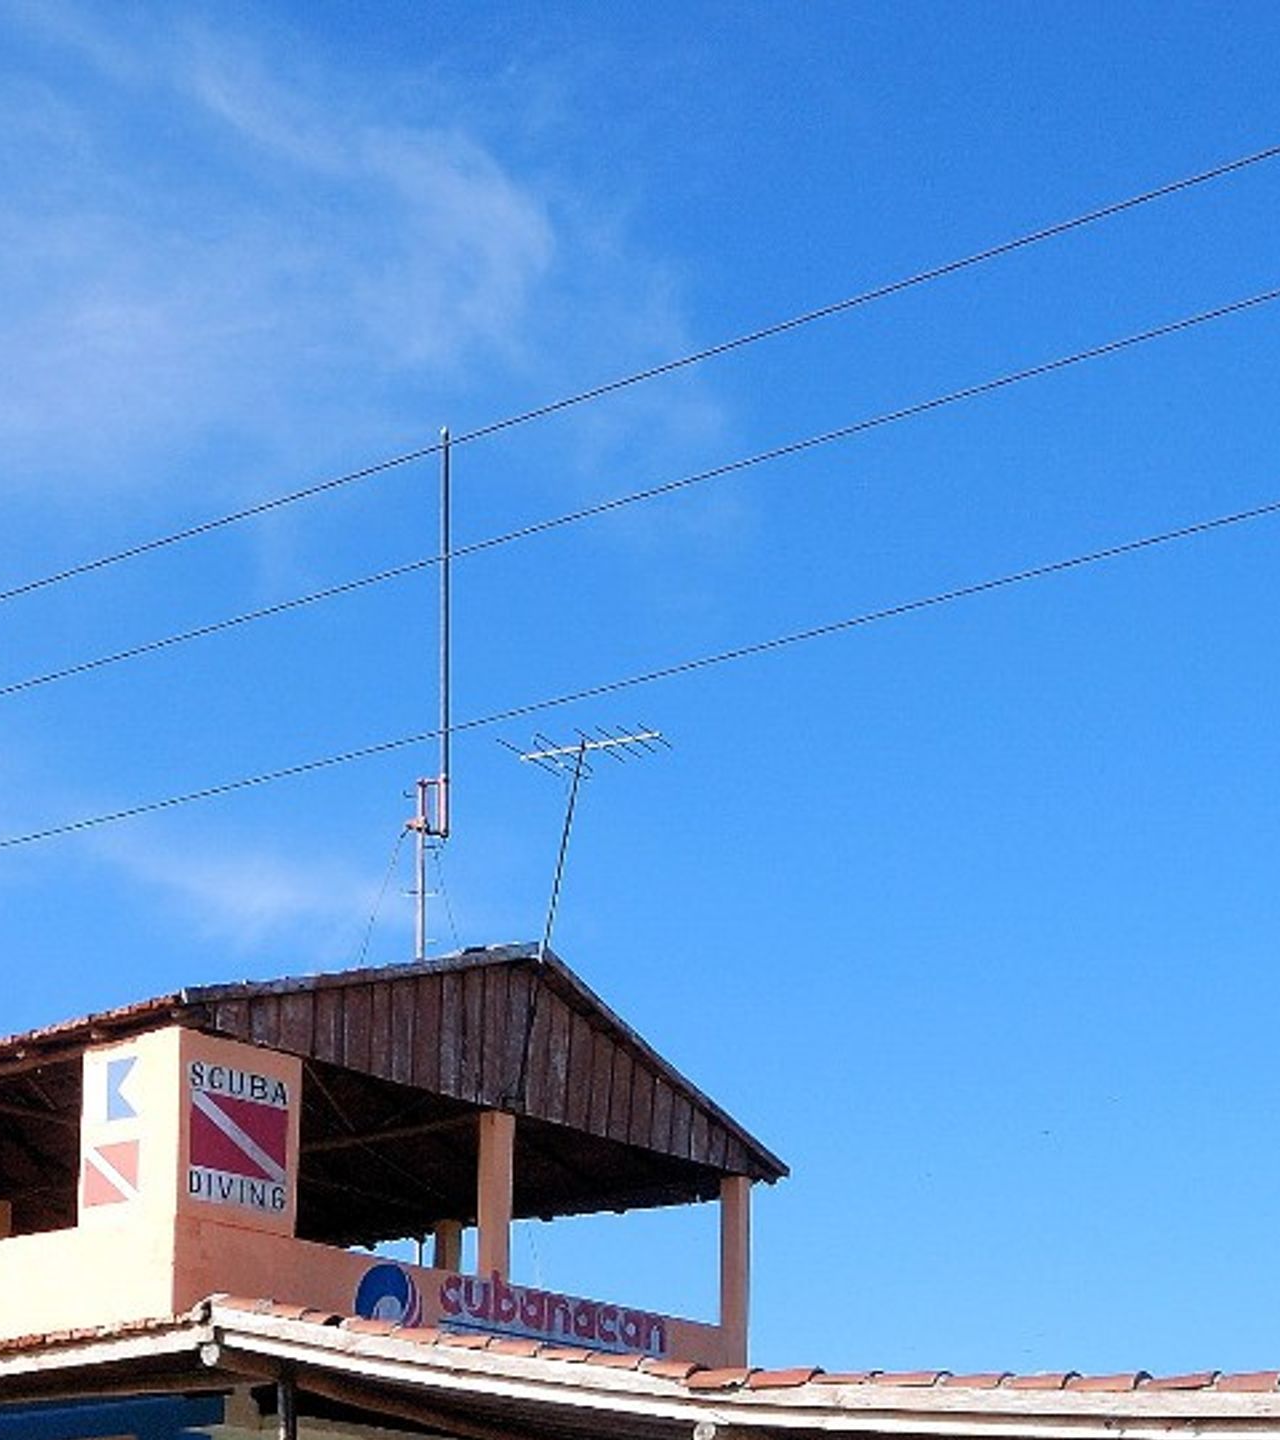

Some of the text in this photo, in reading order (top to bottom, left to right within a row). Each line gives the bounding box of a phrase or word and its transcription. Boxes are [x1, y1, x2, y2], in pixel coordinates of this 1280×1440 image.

[189, 1061, 288, 1105] SCUBA
[189, 1170, 286, 1211] DIVING
[439, 1270, 666, 1352] cubanacan
